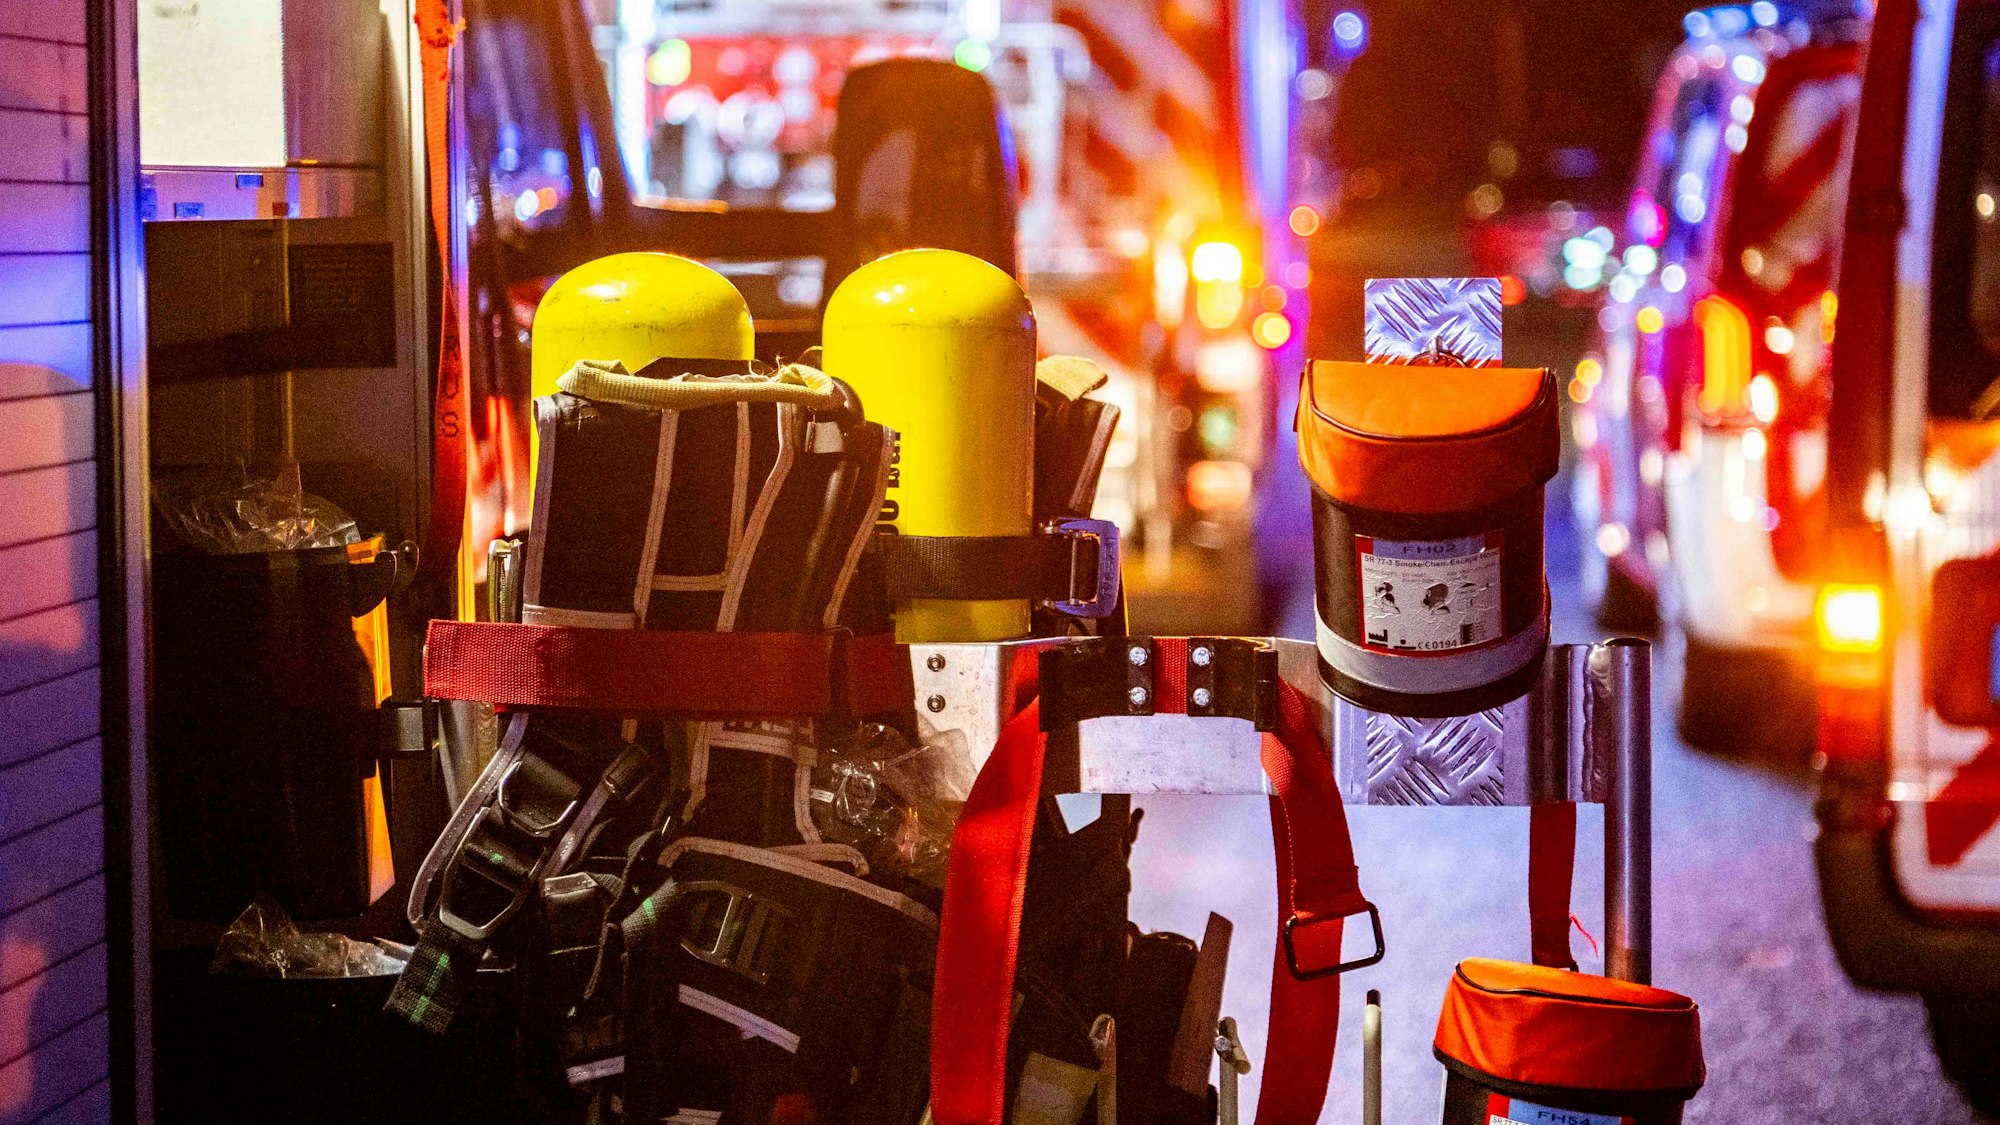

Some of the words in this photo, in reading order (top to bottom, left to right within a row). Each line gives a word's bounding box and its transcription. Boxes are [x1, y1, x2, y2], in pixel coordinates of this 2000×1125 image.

[1403, 543, 1456, 554] FH02
[1364, 554, 1375, 563] SR
[1537, 1110, 1591, 1125] FH54
